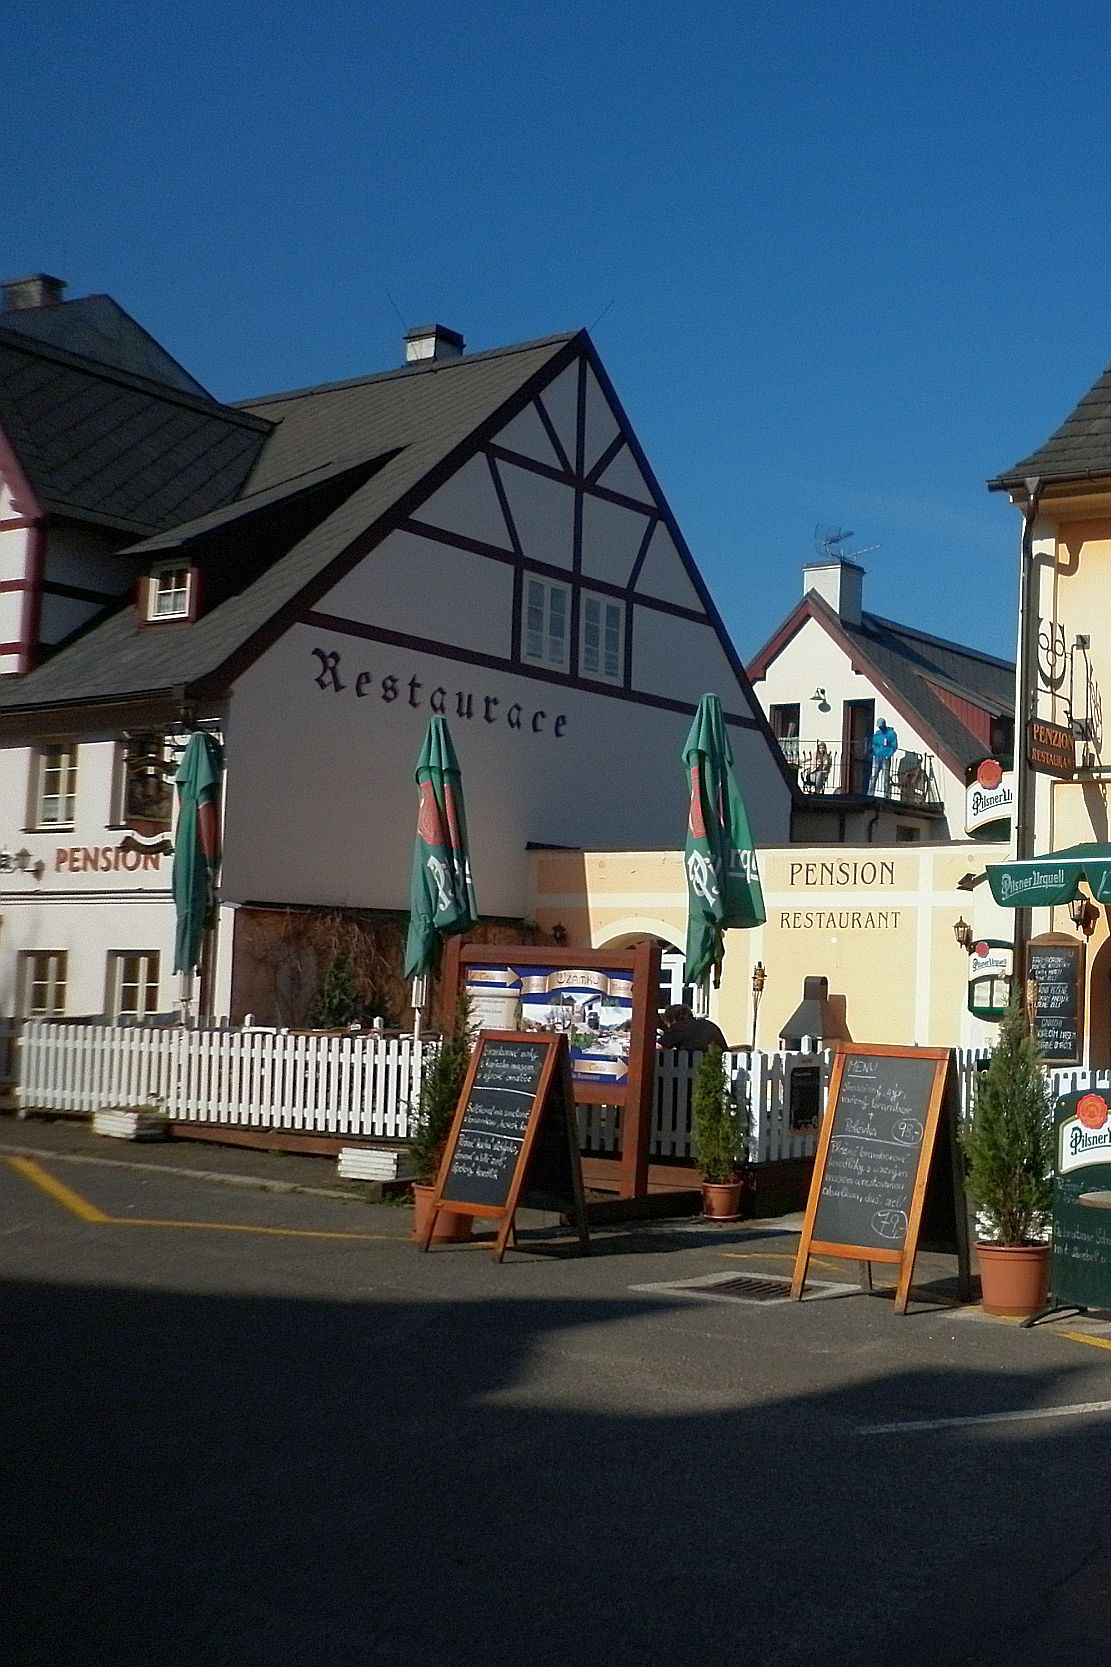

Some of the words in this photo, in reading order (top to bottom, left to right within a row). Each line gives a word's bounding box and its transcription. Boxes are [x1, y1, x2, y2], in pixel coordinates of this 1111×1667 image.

[311, 647, 568, 738] Restaurace
[972, 791, 1003, 816] Pilsner
[55, 846, 161, 872] PENSION
[789, 861, 896, 886] PENSION
[1001, 873, 1033, 900] Pilsner
[1033, 870, 1065, 889] Urquell
[780, 911, 902, 929] RESTAURANT
[847, 1060, 879, 1073] MENU
[1070, 1126, 1108, 1155] Pilsner
